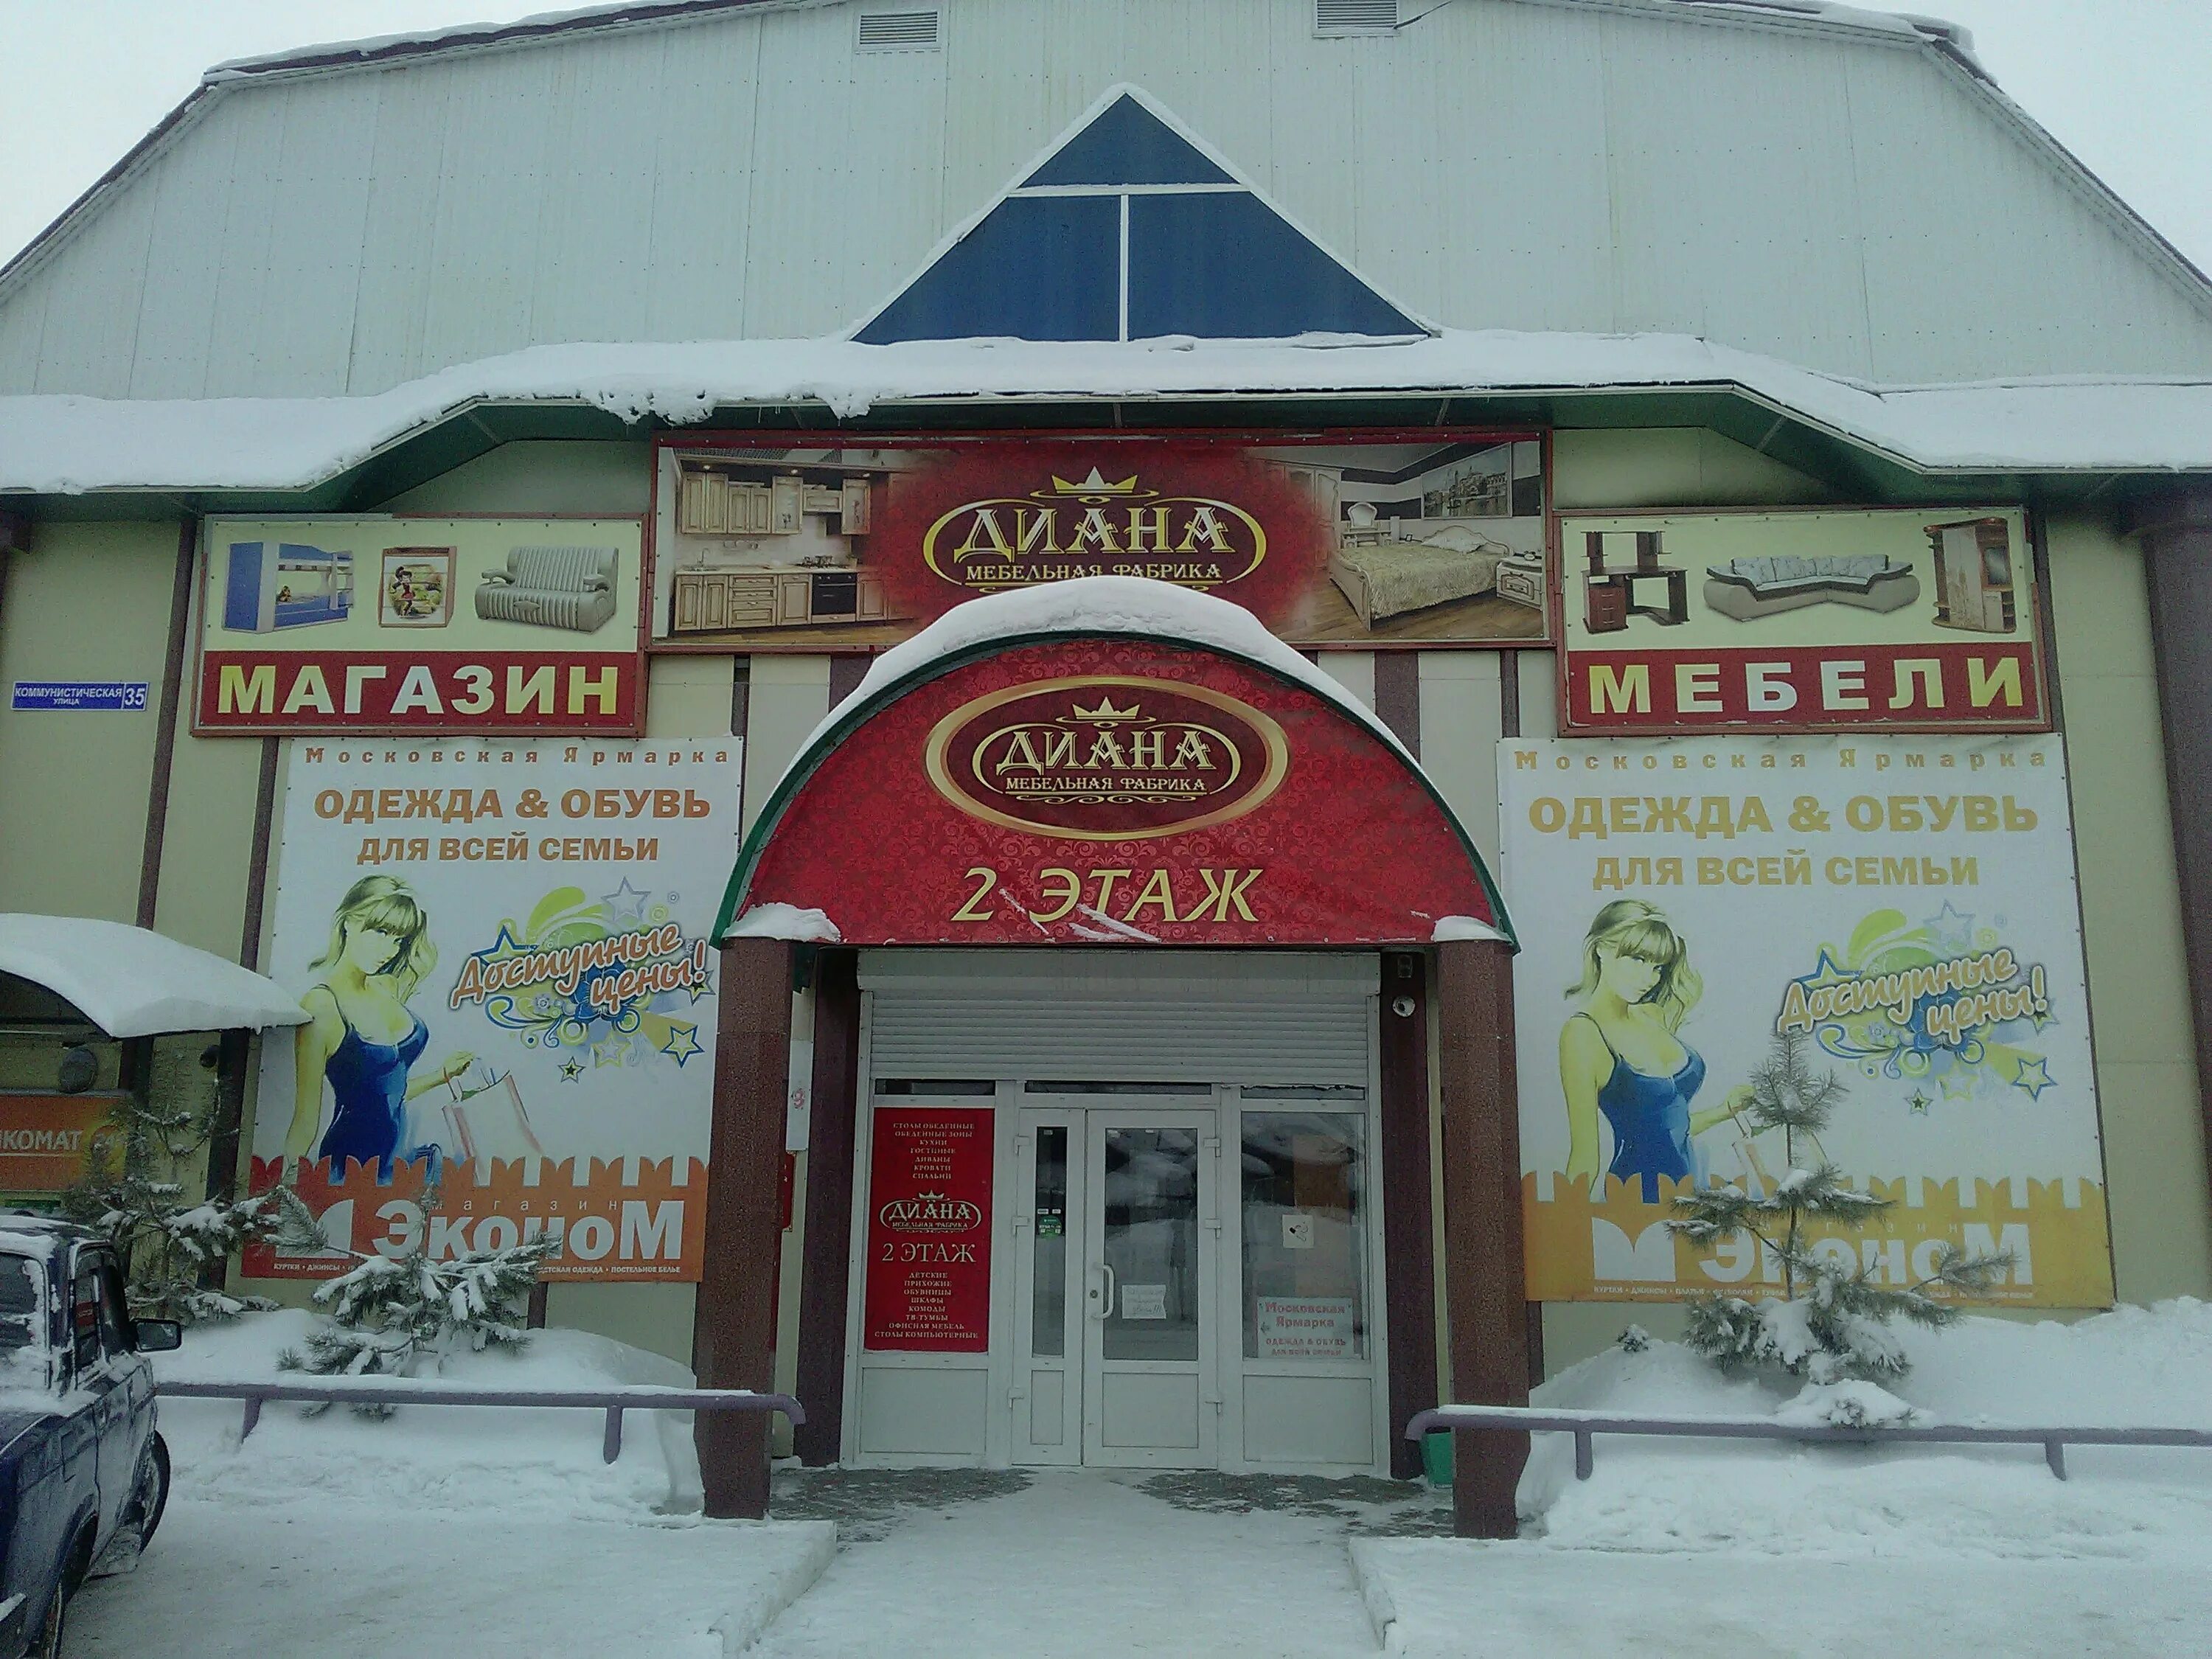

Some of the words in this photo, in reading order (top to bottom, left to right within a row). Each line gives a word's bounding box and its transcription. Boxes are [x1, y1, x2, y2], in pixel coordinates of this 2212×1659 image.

[954, 507, 1236, 563] ДИАНА
[966, 564, 1102, 580] МЕБЕЛЬНАЯ
[1113, 563, 1221, 580] ФАБРИКА
[15, 687, 122, 698] КОММУНИСТИЧЕСКАЯ
[125, 688, 145, 706] 35
[218, 665, 619, 714] МАГАЗИН
[1589, 658, 2023, 714] МЕБЕЛИ
[305, 747, 538, 764] Московская
[564, 747, 728, 766] Ярмарка
[995, 731, 1216, 776] ДИАНА
[1515, 749, 1806, 771] Московская
[1840, 748, 2046, 771] Ярмарка
[1006, 777, 1113, 790] МЕБЕЛЬНАЯ
[1120, 777, 1206, 790] ФАБРИКА
[314, 788, 504, 824] ОДЕЖДА
[516, 788, 549, 818] &
[560, 789, 710, 818] ОБУВЬ
[1528, 796, 1773, 840] ОДЕЖДА
[1788, 796, 1831, 832] &
[1845, 795, 2039, 832] ОБУВЬ
[357, 838, 428, 865] ДЛЯ
[439, 831, 529, 861] ВСЕЙ
[538, 838, 659, 861] СЕМЬИ
[1593, 857, 1683, 891] ДЛЯ
[1697, 849, 1812, 886] ВСЕЙ
[1825, 856, 1979, 886] СЕМЬИ
[950, 867, 998, 921] 2
[1029, 868, 1264, 922] ЭТАЖ
[448, 922, 684, 1009] Доступные
[590, 939, 708, 1015] цены!
[1777, 947, 2018, 1032] Доступные
[1925, 964, 2048, 1045] цены!
[888, 1203, 973, 1221] ДИАНА
[882, 1242, 894, 1262] 2
[900, 1242, 977, 1262] ЭТАЖ
[1265, 1302, 1345, 1313] Московская
[1276, 1315, 1334, 1329] Ярмарка
